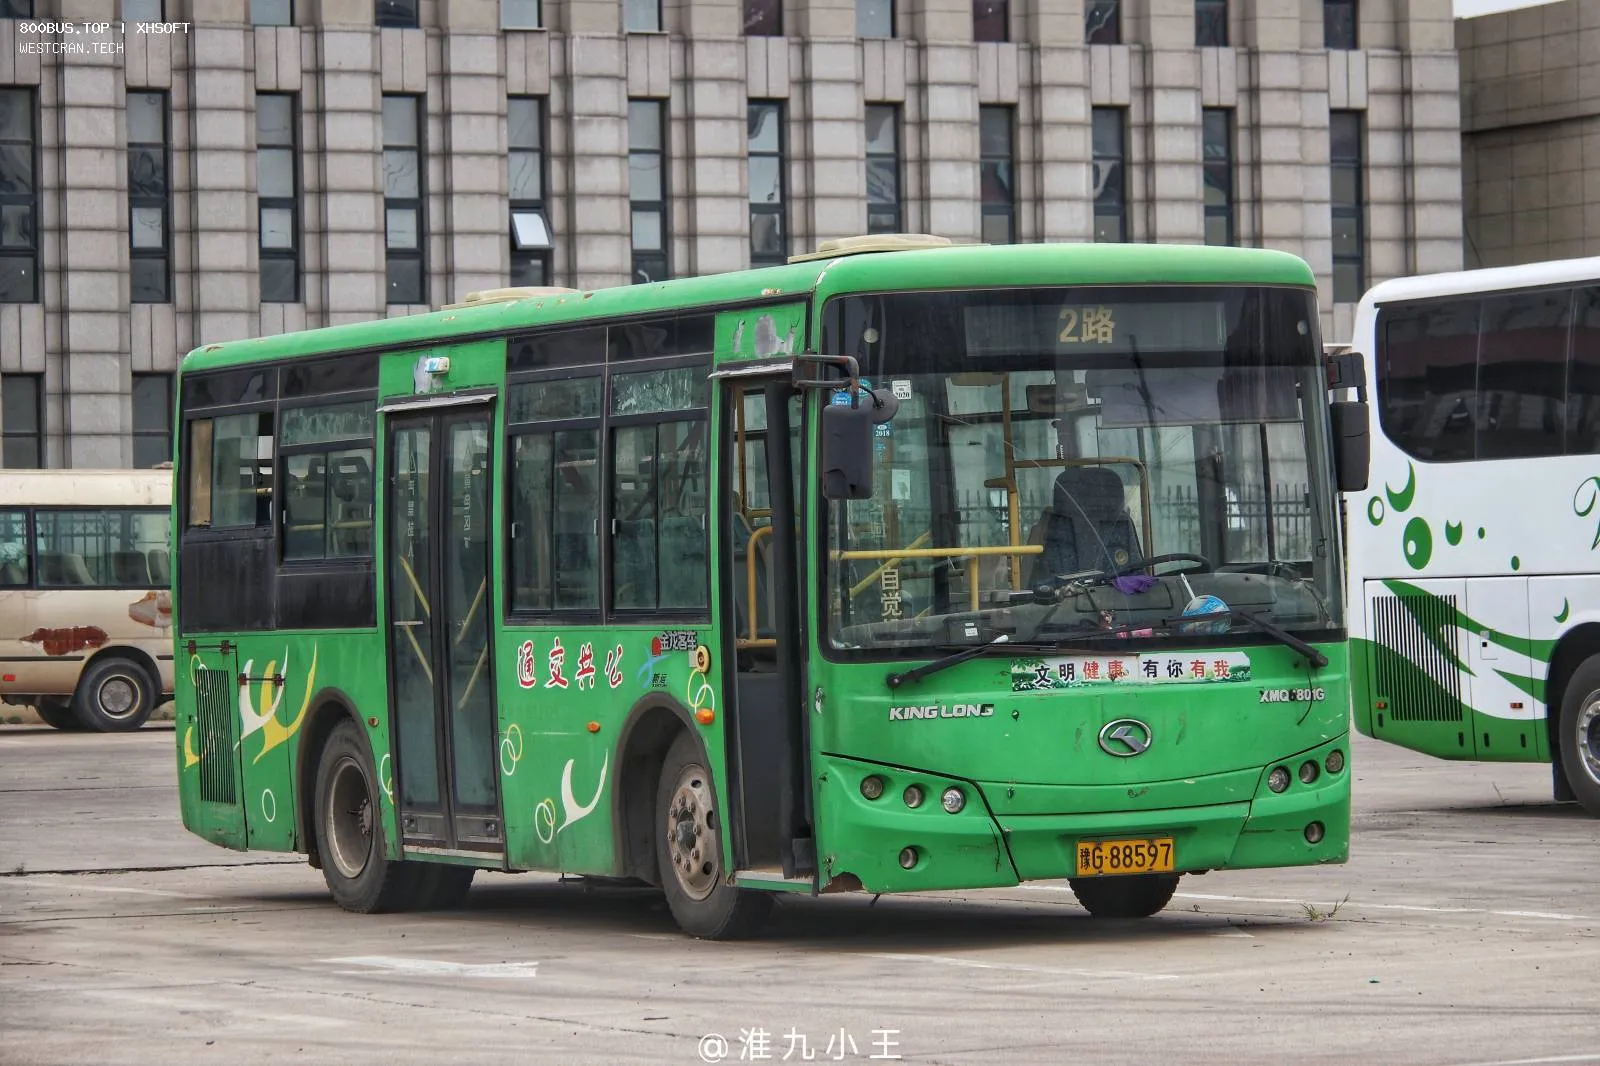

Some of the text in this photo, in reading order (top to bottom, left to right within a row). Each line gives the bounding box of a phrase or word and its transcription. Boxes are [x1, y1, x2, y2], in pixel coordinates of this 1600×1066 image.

[1059, 304, 1114, 344] 2路
[880, 566, 903, 623] 自觉
[1034, 659, 1230, 685] 文明健康 有你有我
[889, 703, 995, 721] KING LONG
